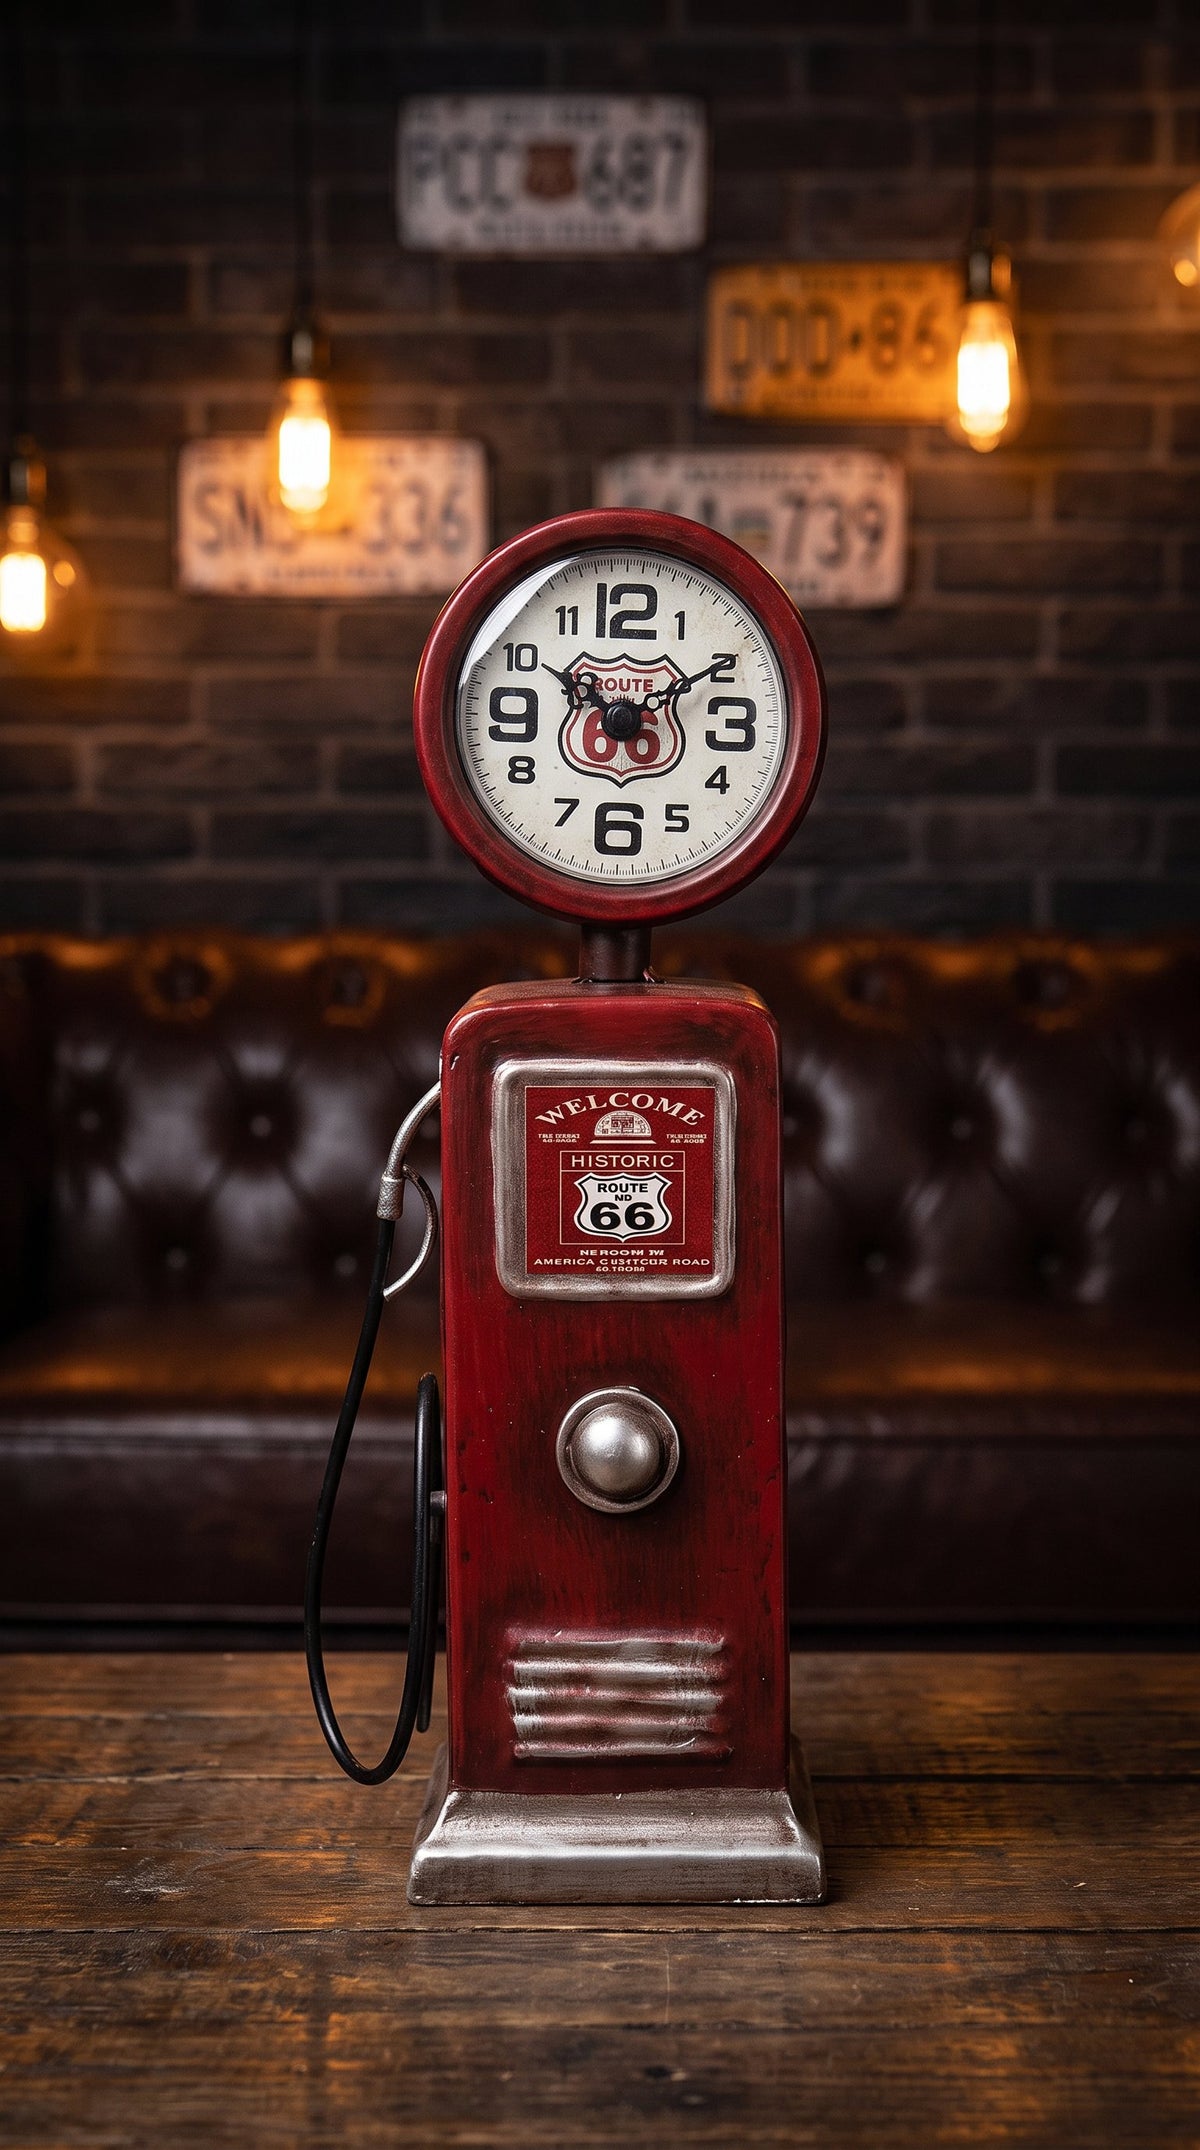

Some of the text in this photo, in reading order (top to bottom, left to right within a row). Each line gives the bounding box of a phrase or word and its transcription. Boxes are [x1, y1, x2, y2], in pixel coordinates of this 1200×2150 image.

[587, 131, 690, 214] 687
[555, 605, 579, 636] 11
[595, 583, 658, 640] 12
[674, 610, 686, 640] 1
[503, 643, 538, 672] 10
[710, 653, 737, 683] 2
[595, 677, 654, 693] ROUTE
[488, 687, 539, 743] 9
[705, 696, 756, 752] 3
[582, 708, 661, 765] 66
[508, 756, 536, 784] 8
[704, 765, 730, 794] 4
[554, 798, 580, 827] 7
[664, 804, 690, 833] 5
[594, 802, 645, 856] 6
[535, 1092, 706, 1127] WELCOME
[571, 1154, 675, 1168] HISTORIC
[596, 1183, 649, 1193] ROUTE
[614, 1194, 633, 1202] ND
[590, 1202, 656, 1231] 66
